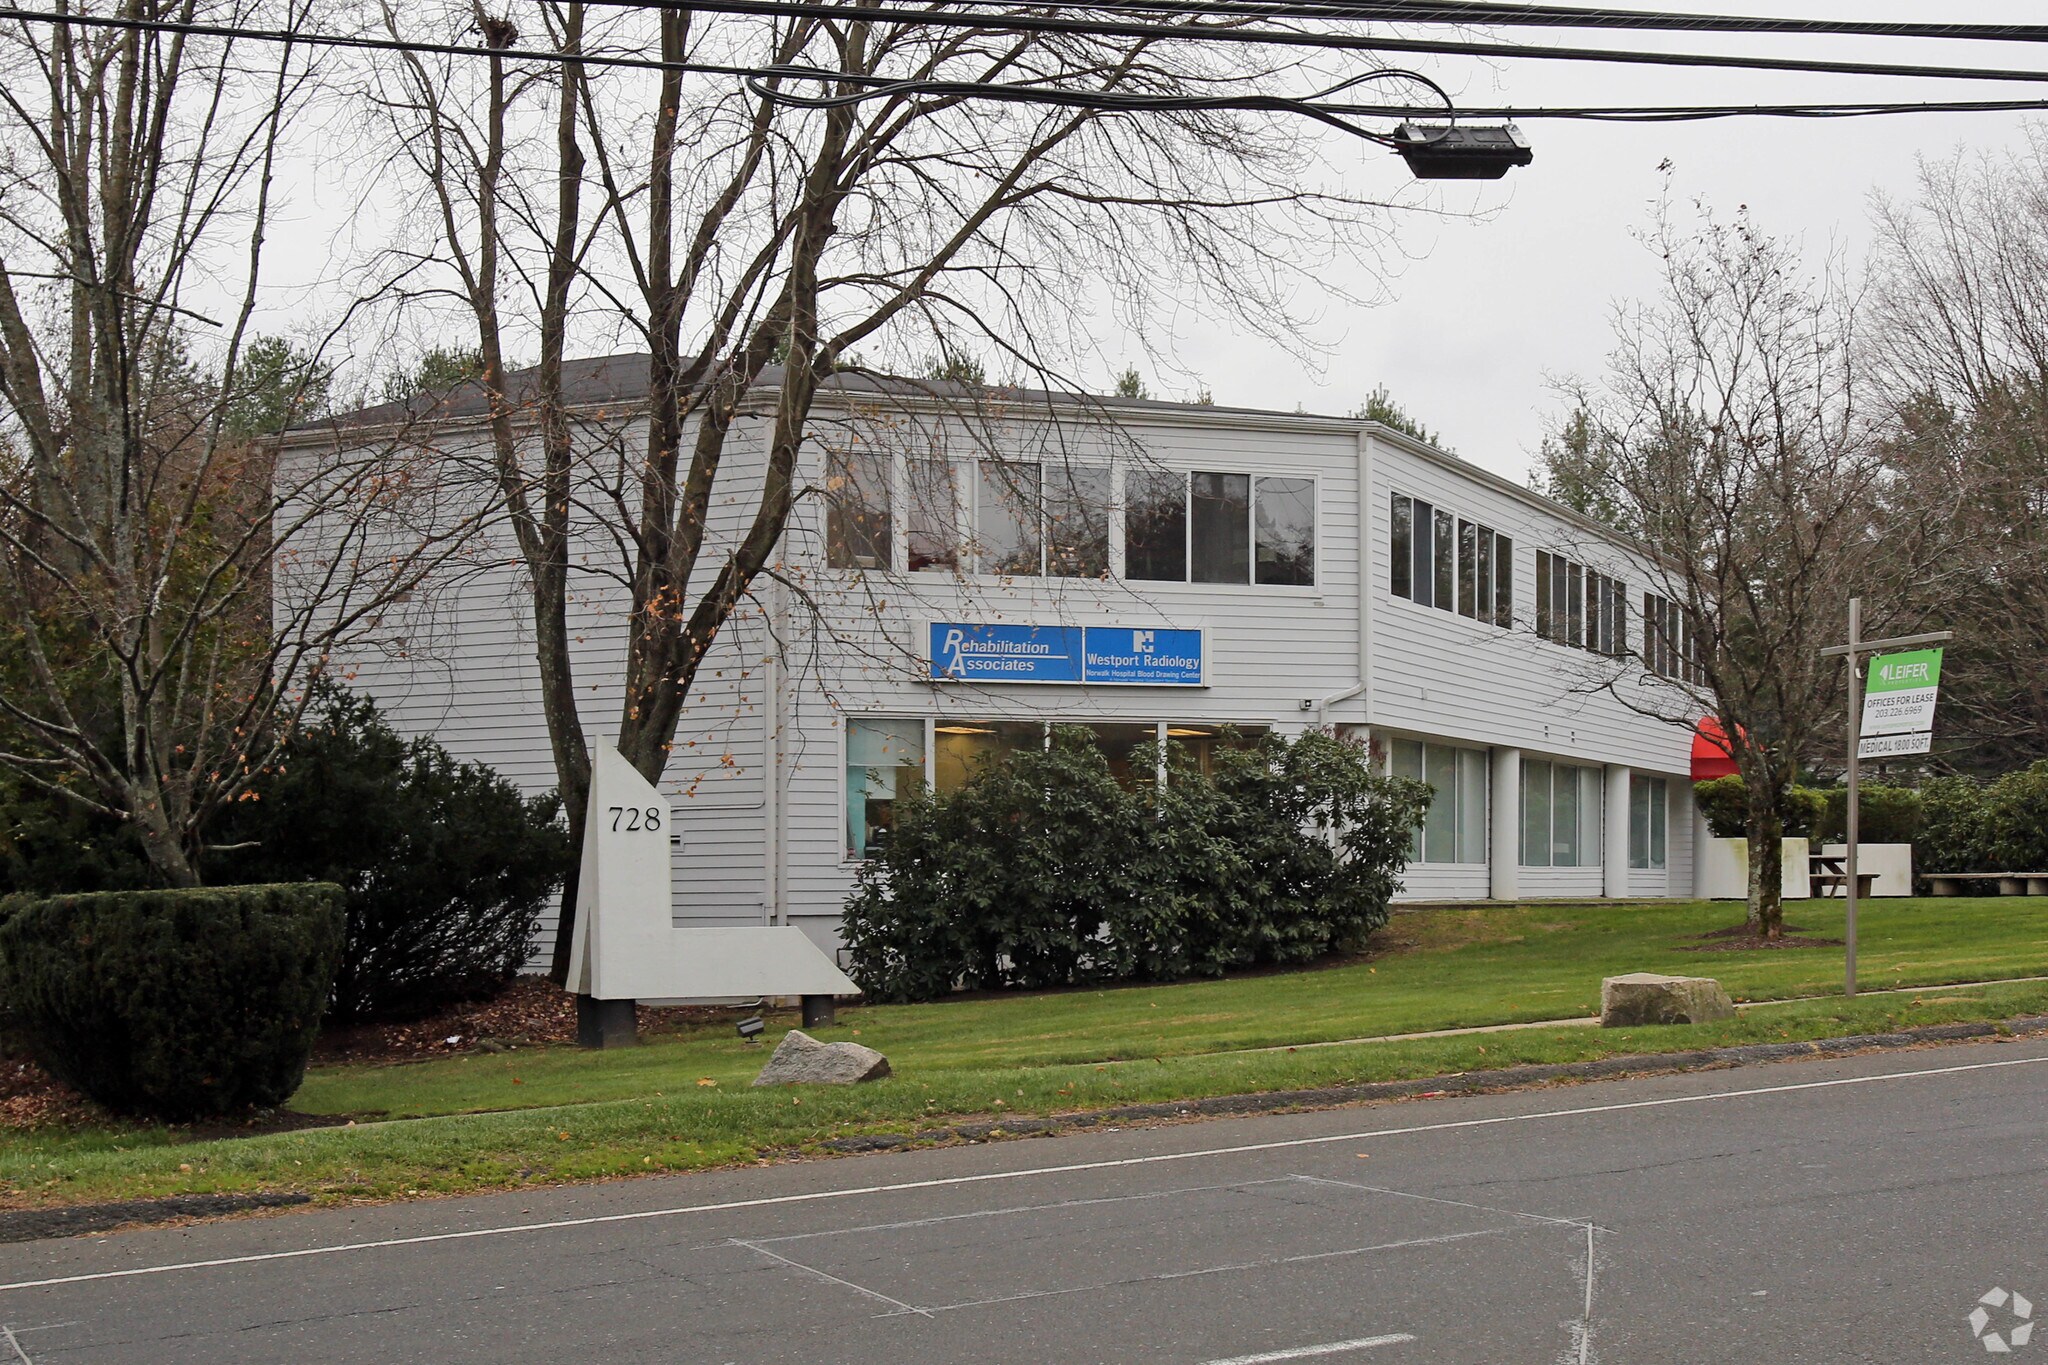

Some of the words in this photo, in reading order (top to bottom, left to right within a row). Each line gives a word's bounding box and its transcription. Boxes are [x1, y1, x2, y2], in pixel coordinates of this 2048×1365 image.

[943, 629, 1049, 654] Rehabilitation
[948, 651, 1035, 676] Associates
[1087, 653, 1139, 668] Westport
[1144, 655, 1200, 669] Radiology
[1111, 670, 1136, 678] Hospital
[1137, 670, 1155, 678] Blood
[1156, 671, 1180, 679] Drawing
[1181, 671, 1200, 679] Center
[1888, 662, 1928, 681] LEIFER
[1867, 697, 1895, 708] OFFICES
[1896, 695, 1911, 705] FOR
[1912, 693, 1934, 703] LEASE
[1860, 740, 1893, 753] MEDICAL
[1894, 739, 1911, 751] 1800
[609, 806, 661, 832] 728
